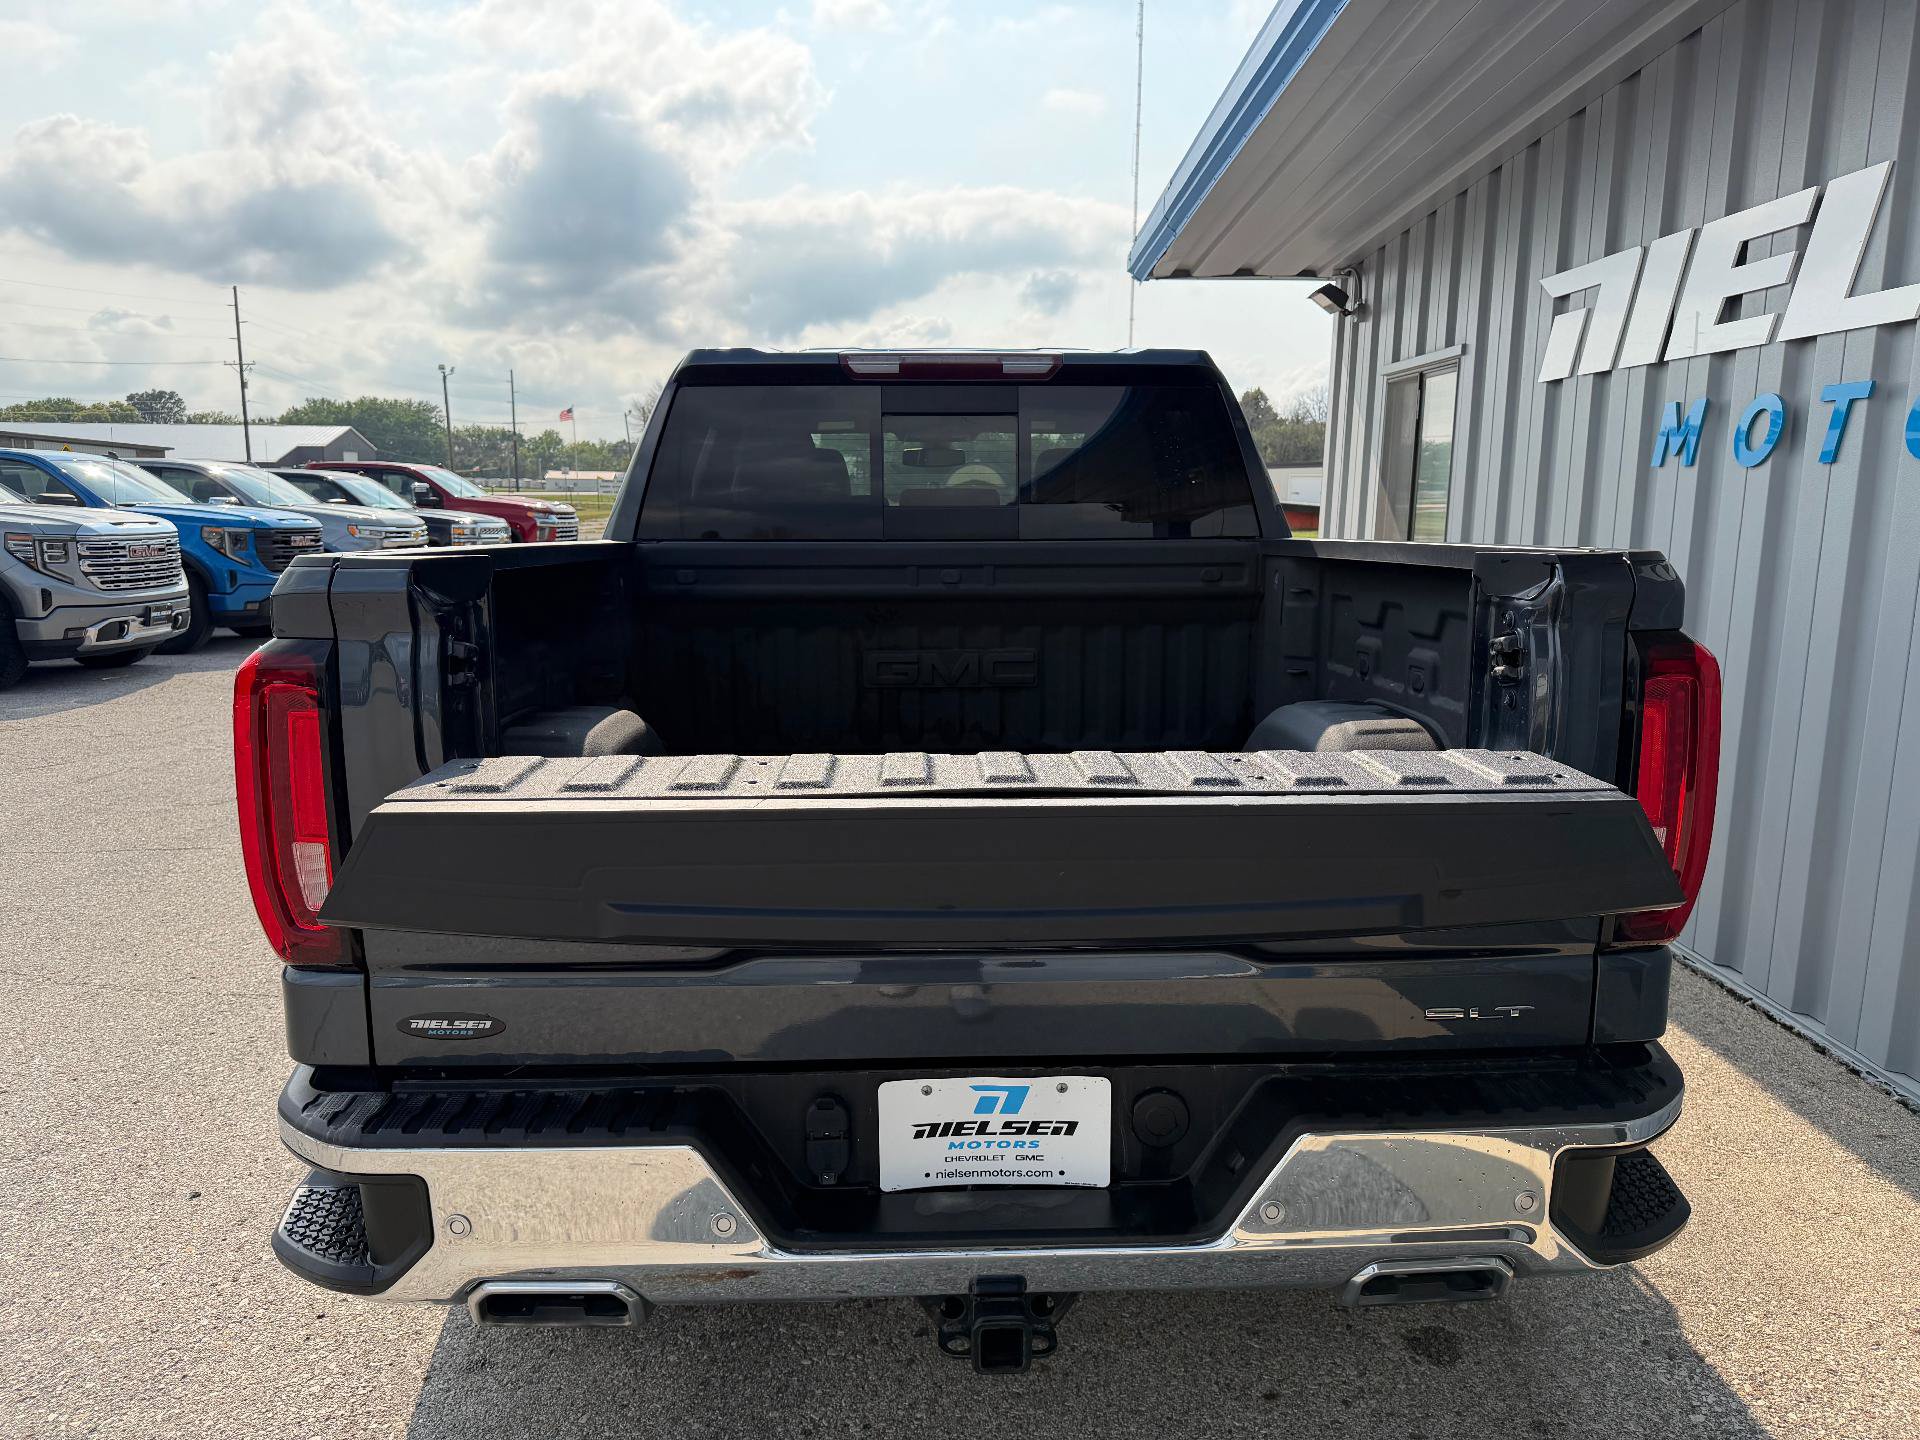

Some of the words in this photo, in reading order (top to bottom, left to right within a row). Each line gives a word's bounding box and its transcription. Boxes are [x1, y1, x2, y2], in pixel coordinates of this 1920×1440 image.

[1650, 380, 1920, 468] MOT
[129, 544, 166, 558] GMC
[866, 652, 1036, 686] GMC
[1425, 1005, 1536, 1020] SLT
[409, 1019, 493, 1029] NIELSEN
[911, 1120, 1079, 1140] NIELSEN
[947, 1140, 1040, 1150] MOTORS
[944, 1154, 1006, 1163] CHEVROLET
[1015, 1154, 1045, 1162] GMC
[935, 1168, 1053, 1179] nielsenmotors.com
